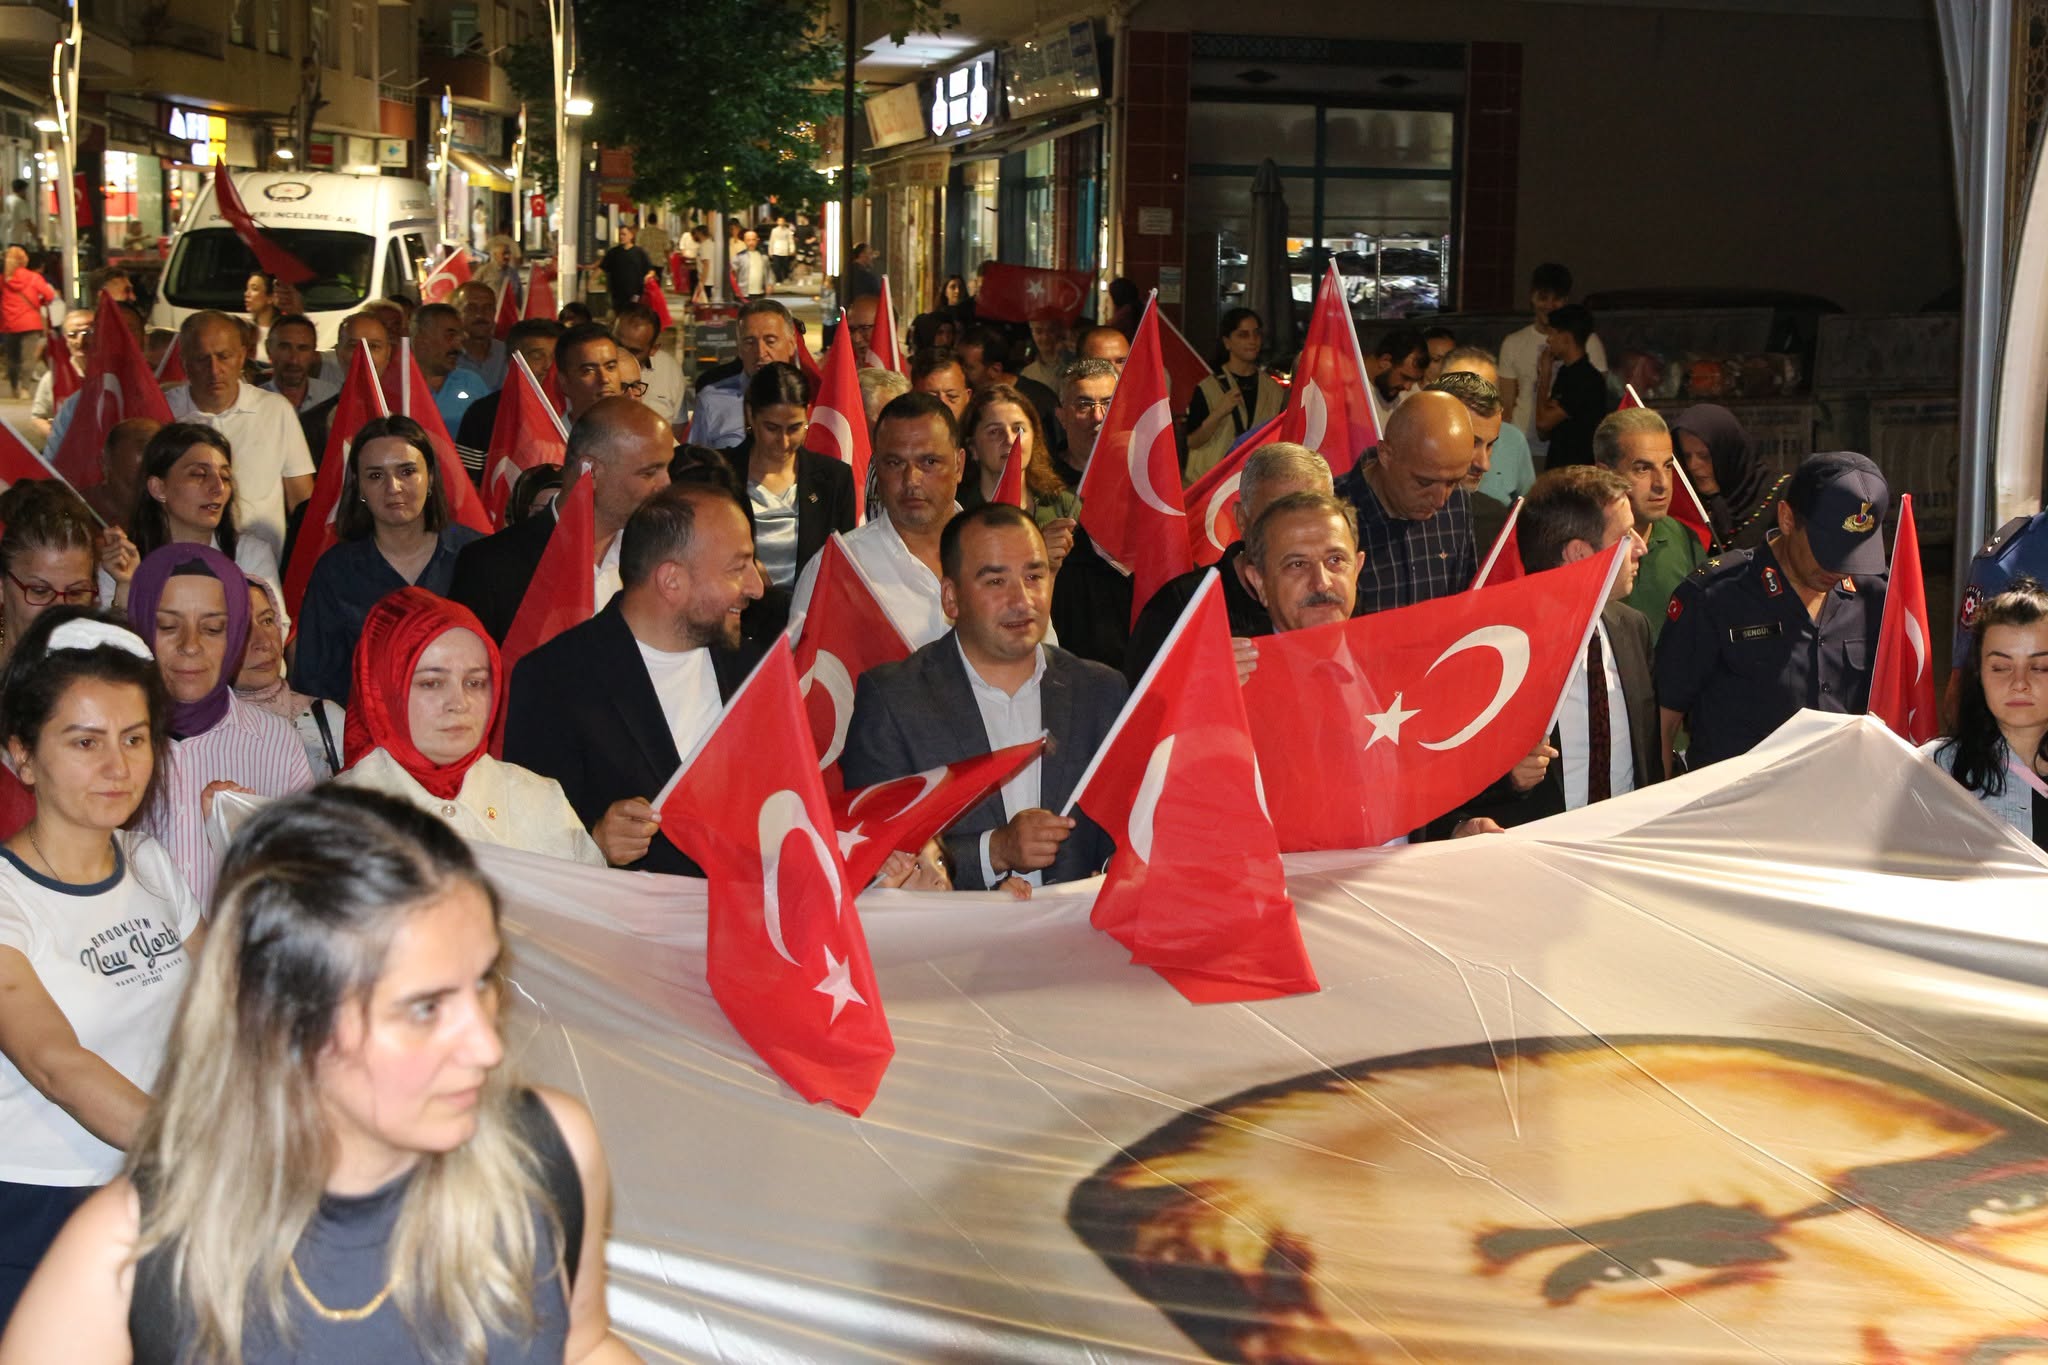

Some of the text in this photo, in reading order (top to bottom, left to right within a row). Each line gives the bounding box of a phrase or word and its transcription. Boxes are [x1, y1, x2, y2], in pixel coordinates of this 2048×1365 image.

[80, 921, 181, 975] New York
[91, 918, 152, 948] BROOKLYN
